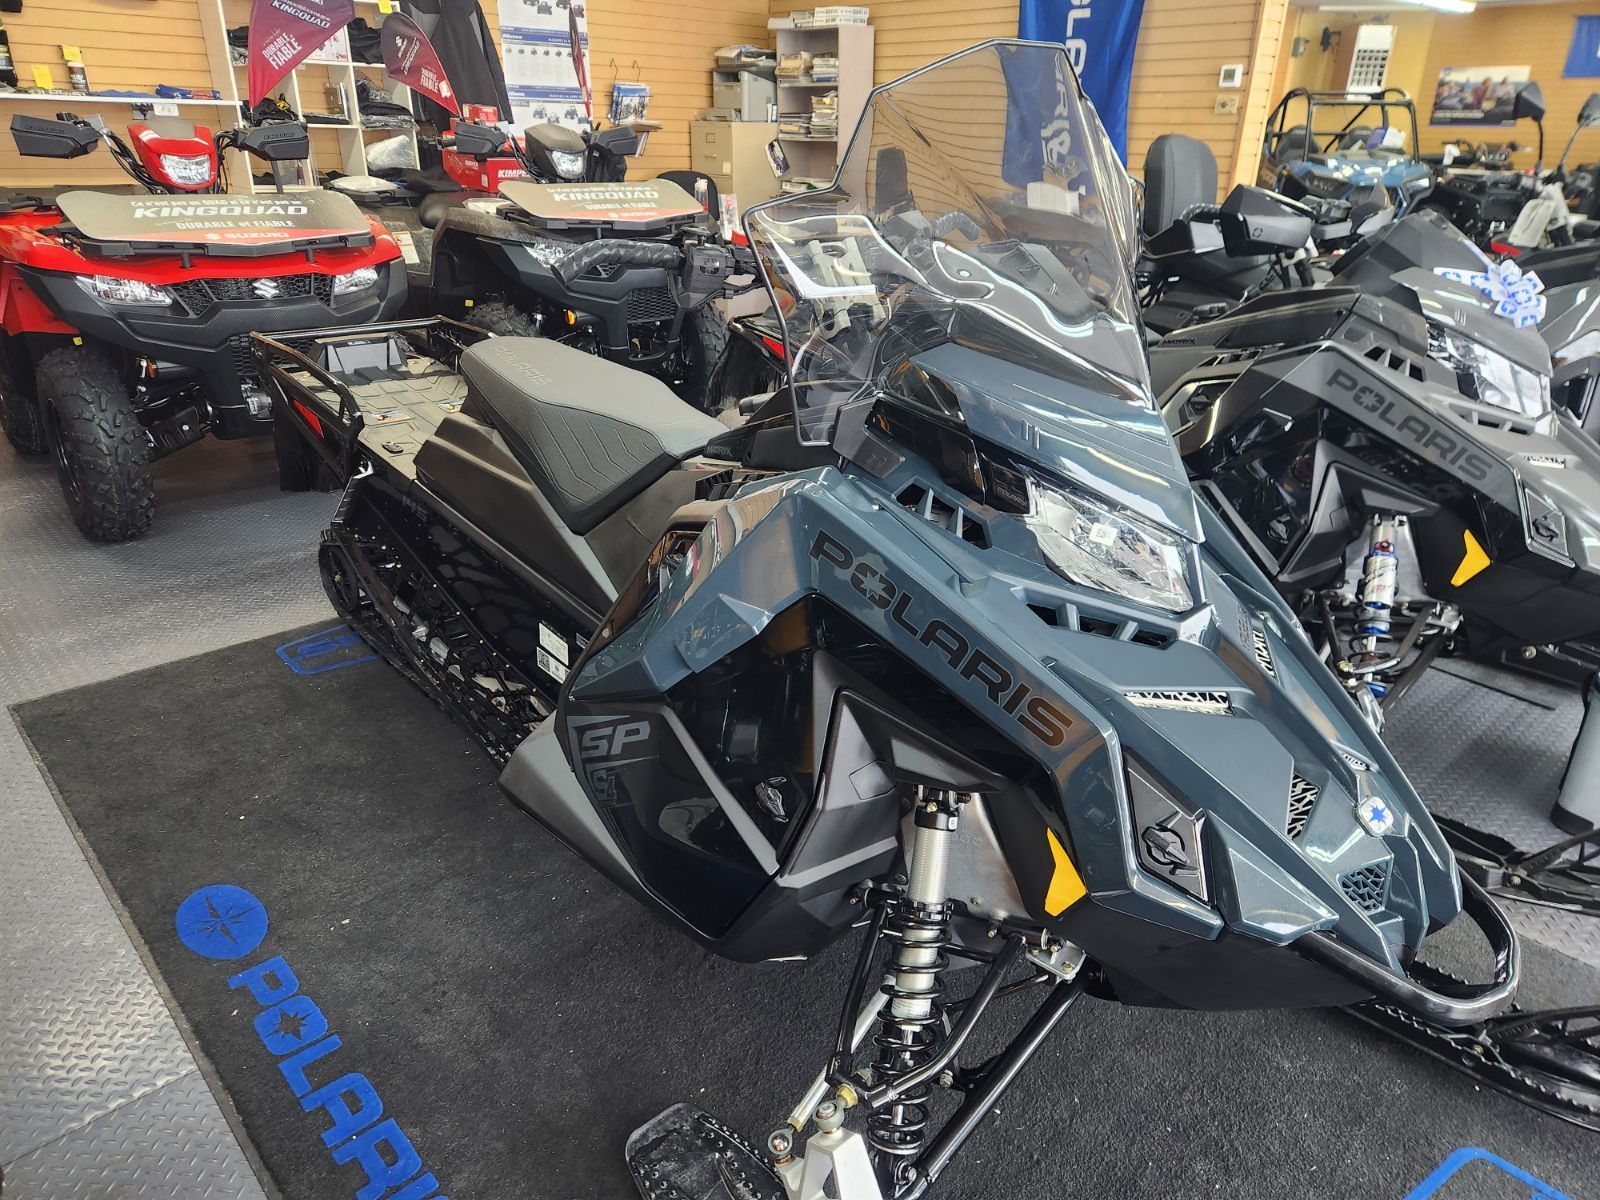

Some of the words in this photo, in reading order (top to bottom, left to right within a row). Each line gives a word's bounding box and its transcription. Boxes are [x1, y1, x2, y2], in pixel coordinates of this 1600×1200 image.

[271, 1, 331, 29] KINGQUAD
[262, 32, 290, 58] DURABLE
[268, 37, 302, 70] FIABLE
[498, 169, 535, 178] KIMPE
[553, 191, 659, 201] KINGQUAD
[134, 205, 308, 218] KINGQUAD
[176, 221, 237, 230] DURABLE
[238, 220, 250, 228] et
[253, 219, 296, 228] FIABLE
[1326, 367, 1493, 481] POLARIS
[809, 528, 1073, 747] POLARIS
[580, 720, 651, 758] SP
[227, 954, 453, 1200] POLARI
